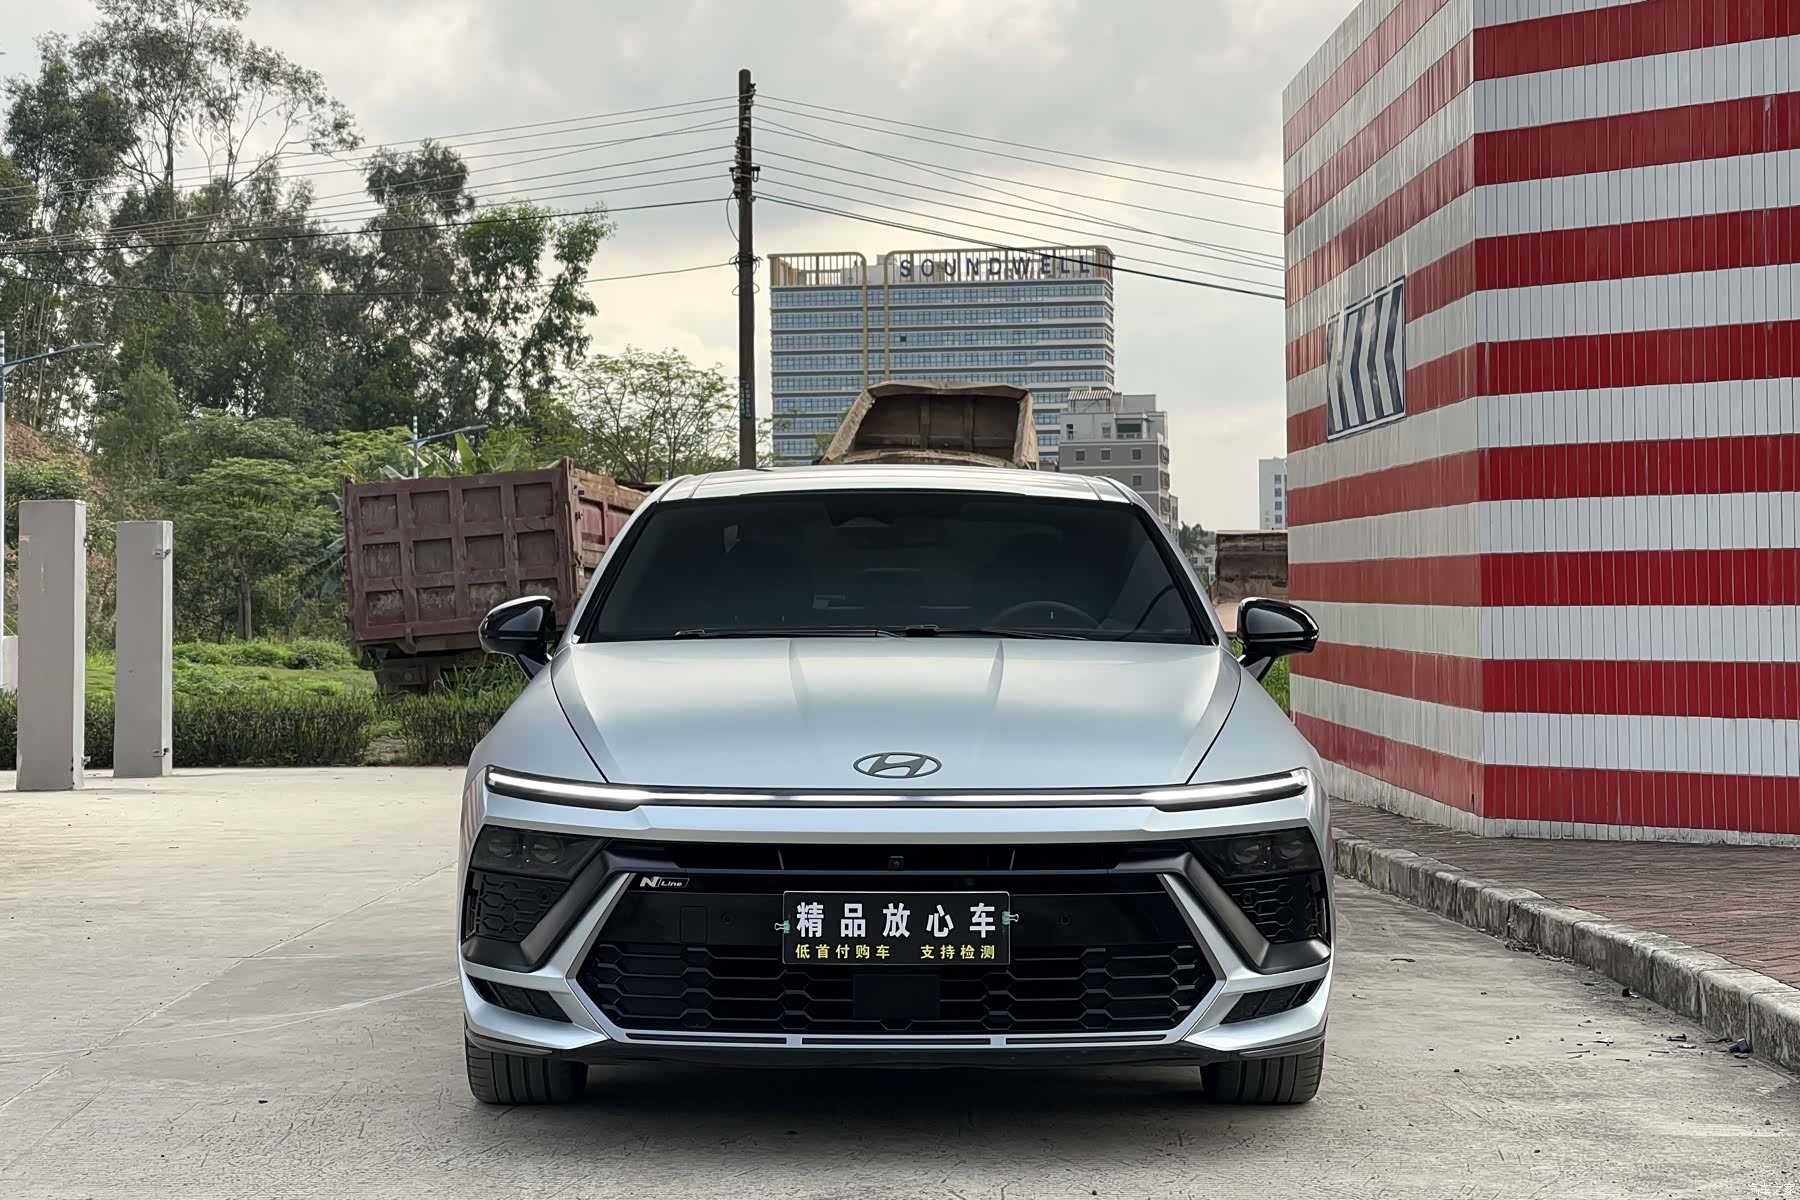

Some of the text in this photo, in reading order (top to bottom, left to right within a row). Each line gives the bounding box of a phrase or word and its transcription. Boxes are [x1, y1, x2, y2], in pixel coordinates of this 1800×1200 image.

[900, 254, 1090, 278] SOUNDWELL
[640, 876, 660, 887] N
[796, 902, 996, 938] 精品放心车
[795, 943, 995, 959] 低首付购车 支持检测
